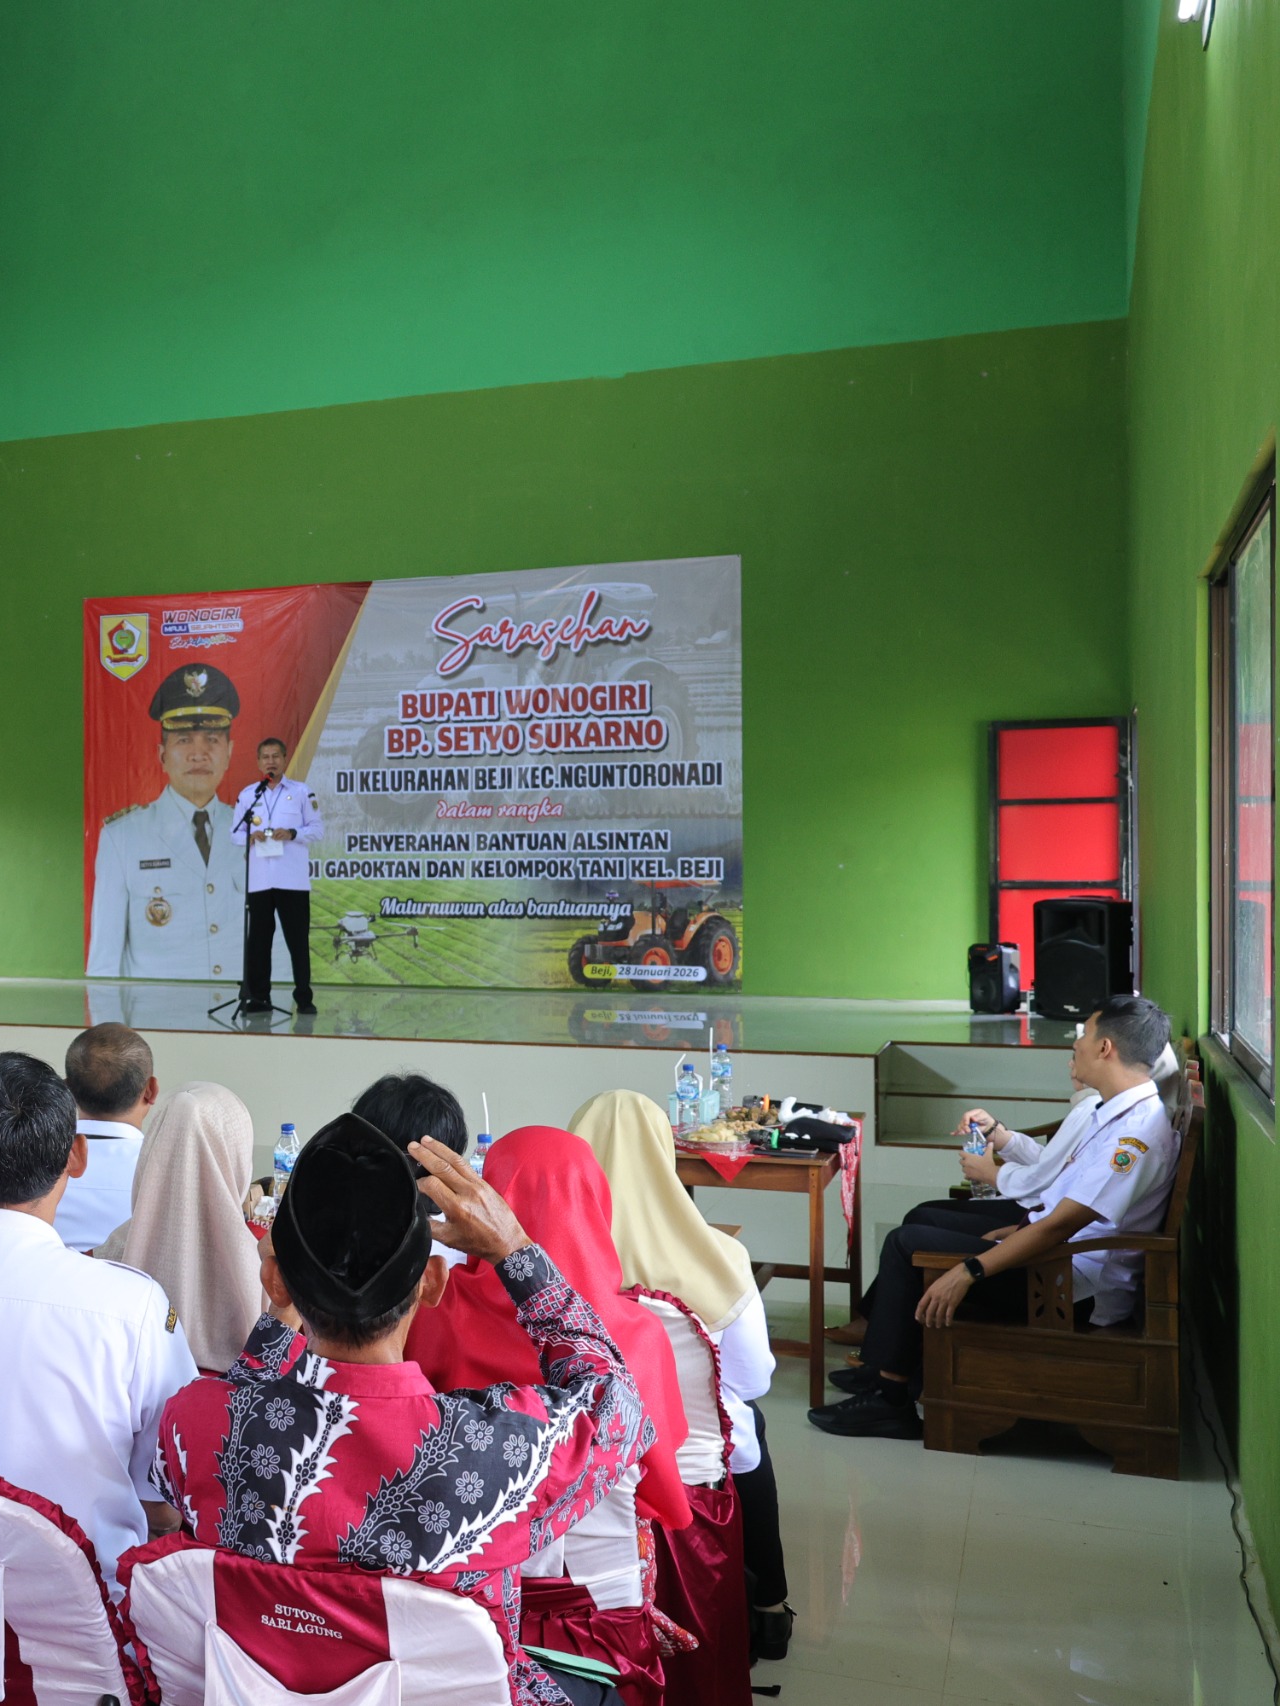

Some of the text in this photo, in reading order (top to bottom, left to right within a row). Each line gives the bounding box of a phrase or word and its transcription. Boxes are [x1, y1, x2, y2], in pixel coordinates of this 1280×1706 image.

[162, 607, 241, 623] WONOGIRI
[164, 624, 187, 633] MAJU
[432, 589, 648, 675] Sarasehan
[401, 683, 648, 719] BUPATI WONOGIRI
[387, 719, 664, 754] BP. SETYO SUKARNO
[336, 762, 722, 793] DI KELURAHAN BEJI KEC.NGUNTORONADI
[436, 800, 493, 819] dalam
[497, 797, 563, 823] rangka
[347, 832, 669, 852] PENYERAHAN BANTUAN ALSINTAN
[325, 860, 420, 878] GAPOKTAN
[426, 860, 465, 878] DAN
[471, 859, 572, 878] KELOMPOK
[579, 859, 624, 877] TANI
[632, 859, 674, 877] KEL.
[680, 859, 722, 878] BEJI
[380, 897, 632, 920] Maturnuwun atas bantuannya
[591, 966, 699, 977] Beji, 28 Januari 2026
[275, 1604, 325, 1625] SUTOYO
[261, 1615, 343, 1640] SARI AGUNG
